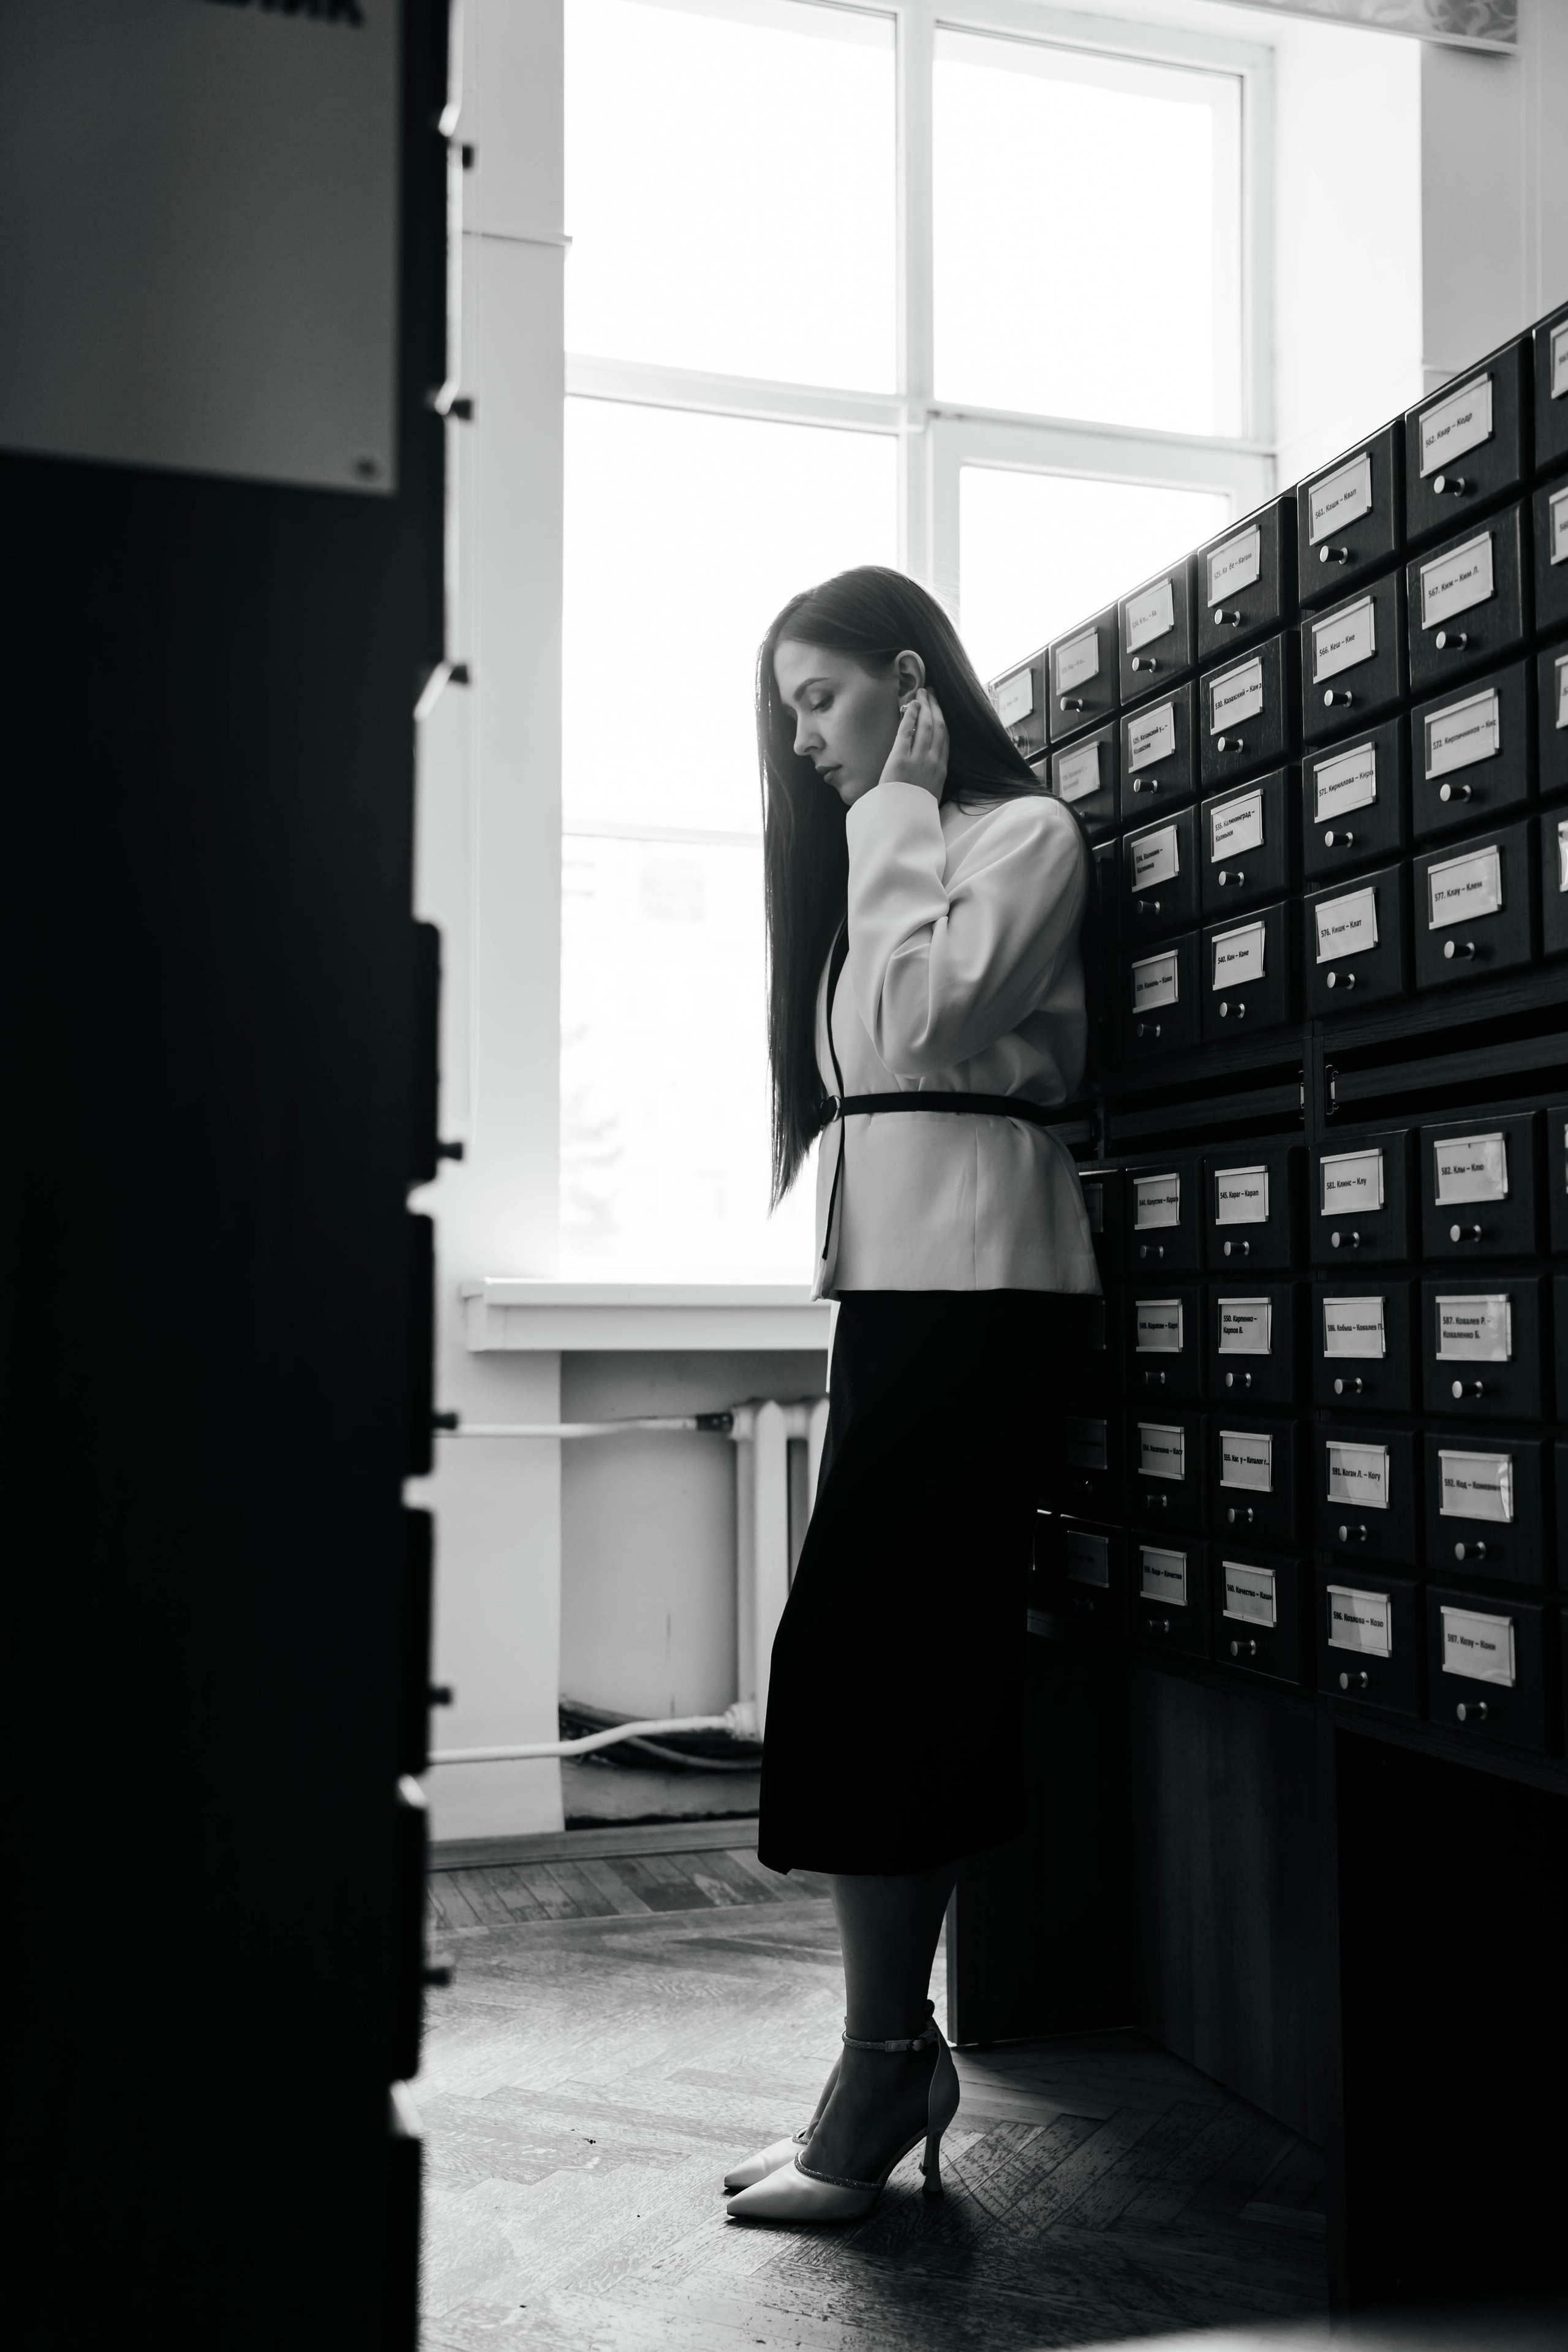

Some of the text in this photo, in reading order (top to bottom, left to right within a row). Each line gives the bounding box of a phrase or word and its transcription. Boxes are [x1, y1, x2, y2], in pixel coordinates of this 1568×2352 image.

[1425, 435, 1436, 448] 562.
[1437, 426, 1450, 439] Квар
[1457, 413, 1472, 426] Кедр
[1315, 508, 1325, 519] 561.
[1325, 500, 1339, 512] Кашк
[1344, 489, 1356, 500] Квап
[1428, 587, 1440, 598] 567.
[1441, 581, 1453, 591] Киж
[1459, 571, 1471, 581] Ким
[1472, 566, 1479, 575] Л.
[1319, 647, 1329, 657] 566.
[1330, 642, 1340, 651] Кеш
[1345, 635, 1355, 643] Кие
[1224, 689, 1245, 705] Казахский
[1433, 740, 1443, 750] 572.
[1319, 788, 1328, 796] 571.
[1329, 777, 1354, 792] Кириллова
[1359, 770, 1373, 781] Кирп
[1223, 812, 1251, 827] Калининград
[1215, 831, 1233, 842] Калмыки
[1434, 892, 1446, 902] 577.
[1447, 888, 1460, 897] Клау
[1321, 929, 1331, 937] 576.
[1331, 925, 1345, 934] Кишк
[1441, 1167, 1452, 1175] 582.
[1342, 1468, 1356, 1477] Коган
[1368, 1472, 1381, 1481] Когу
[1444, 1479, 1455, 1487] 592.
[1235, 1586, 1256, 1597] Качество
[1333, 1611, 1343, 1620] 596.
[1344, 1613, 1365, 1624] Козлова
[1370, 1618, 1384, 1627] Козо
[1447, 1634, 1459, 1643] 597.
